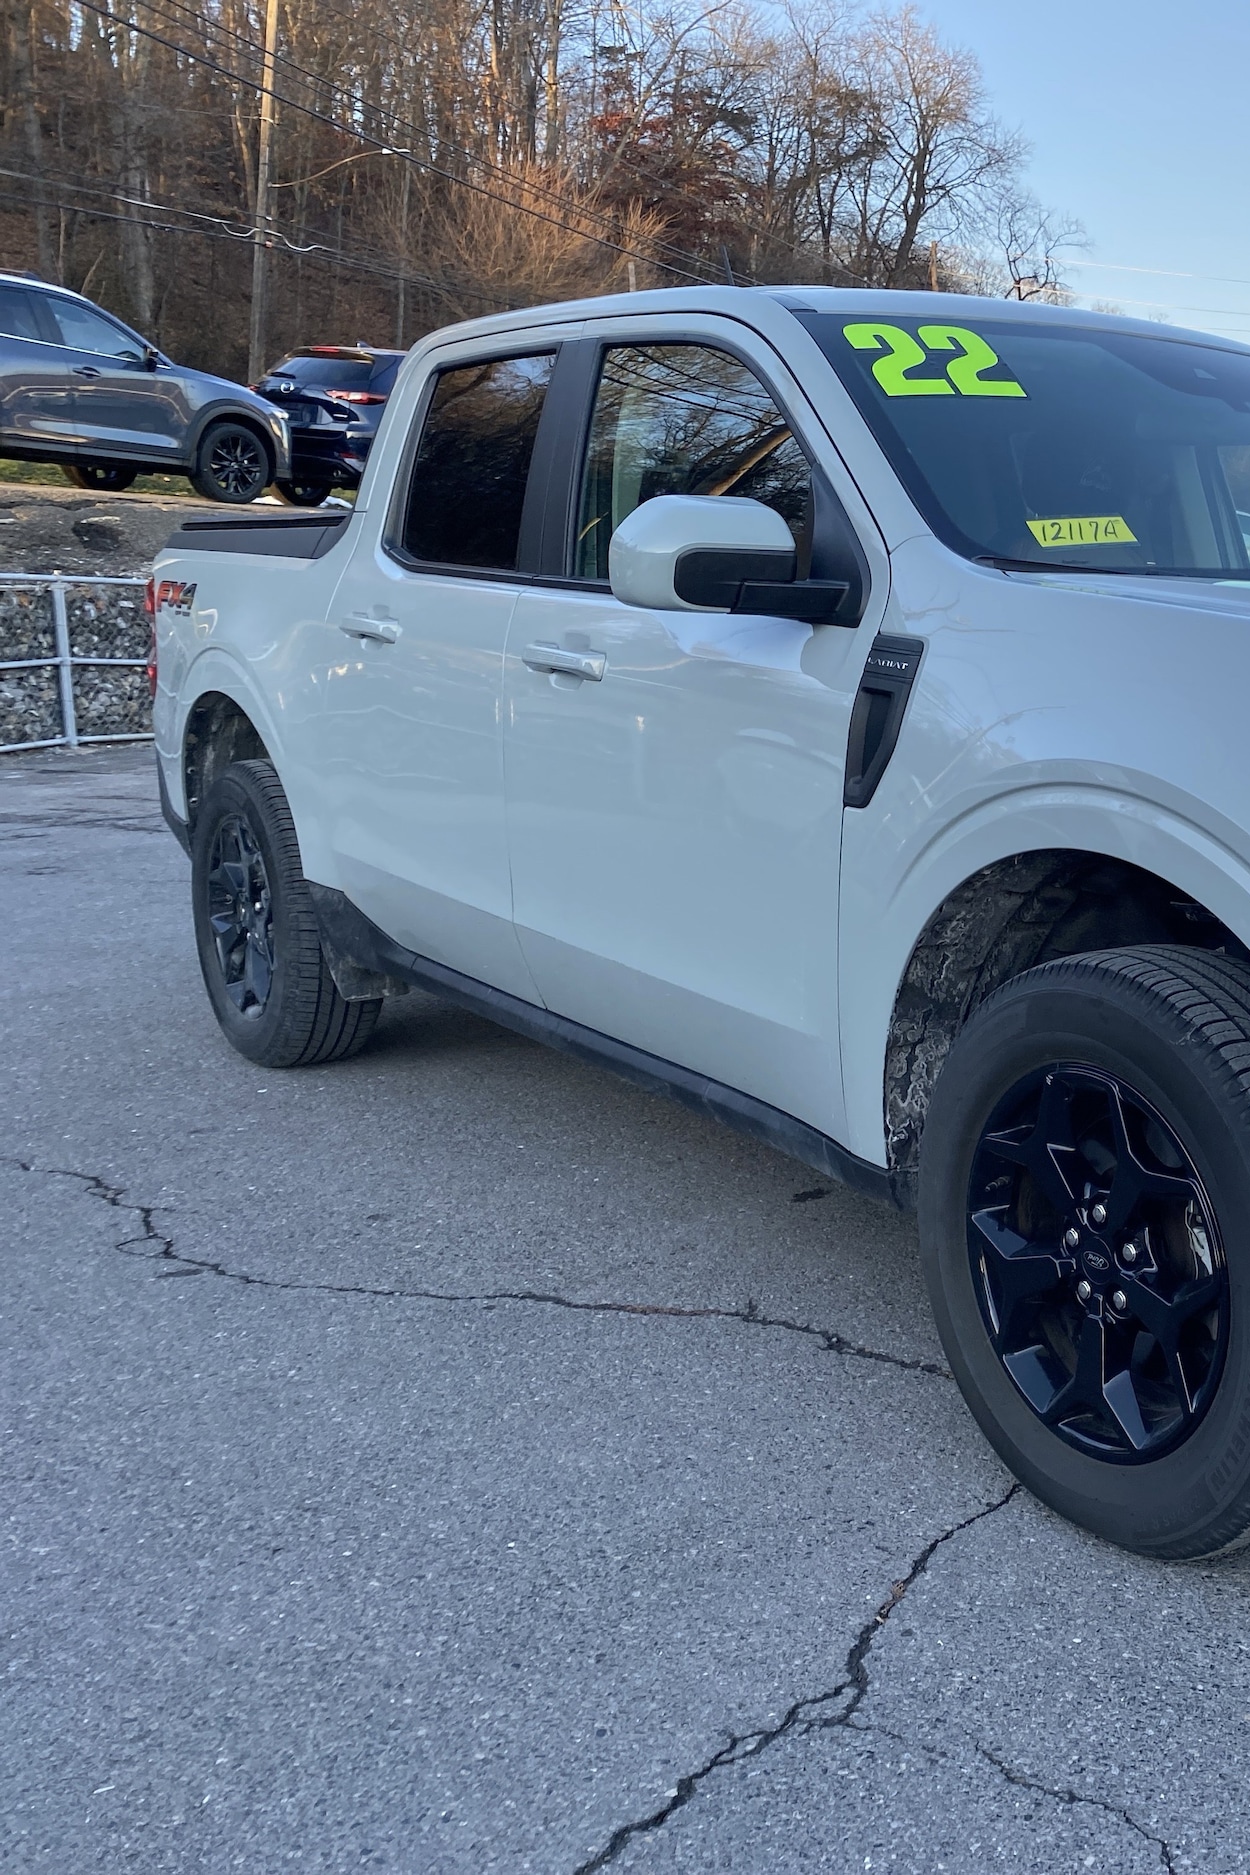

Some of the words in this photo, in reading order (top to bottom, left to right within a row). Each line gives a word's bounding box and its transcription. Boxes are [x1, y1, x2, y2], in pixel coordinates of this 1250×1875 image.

[843, 323, 1027, 397] 22
[1042, 520, 1119, 542] 12117A
[156, 580, 198, 612] FX4
